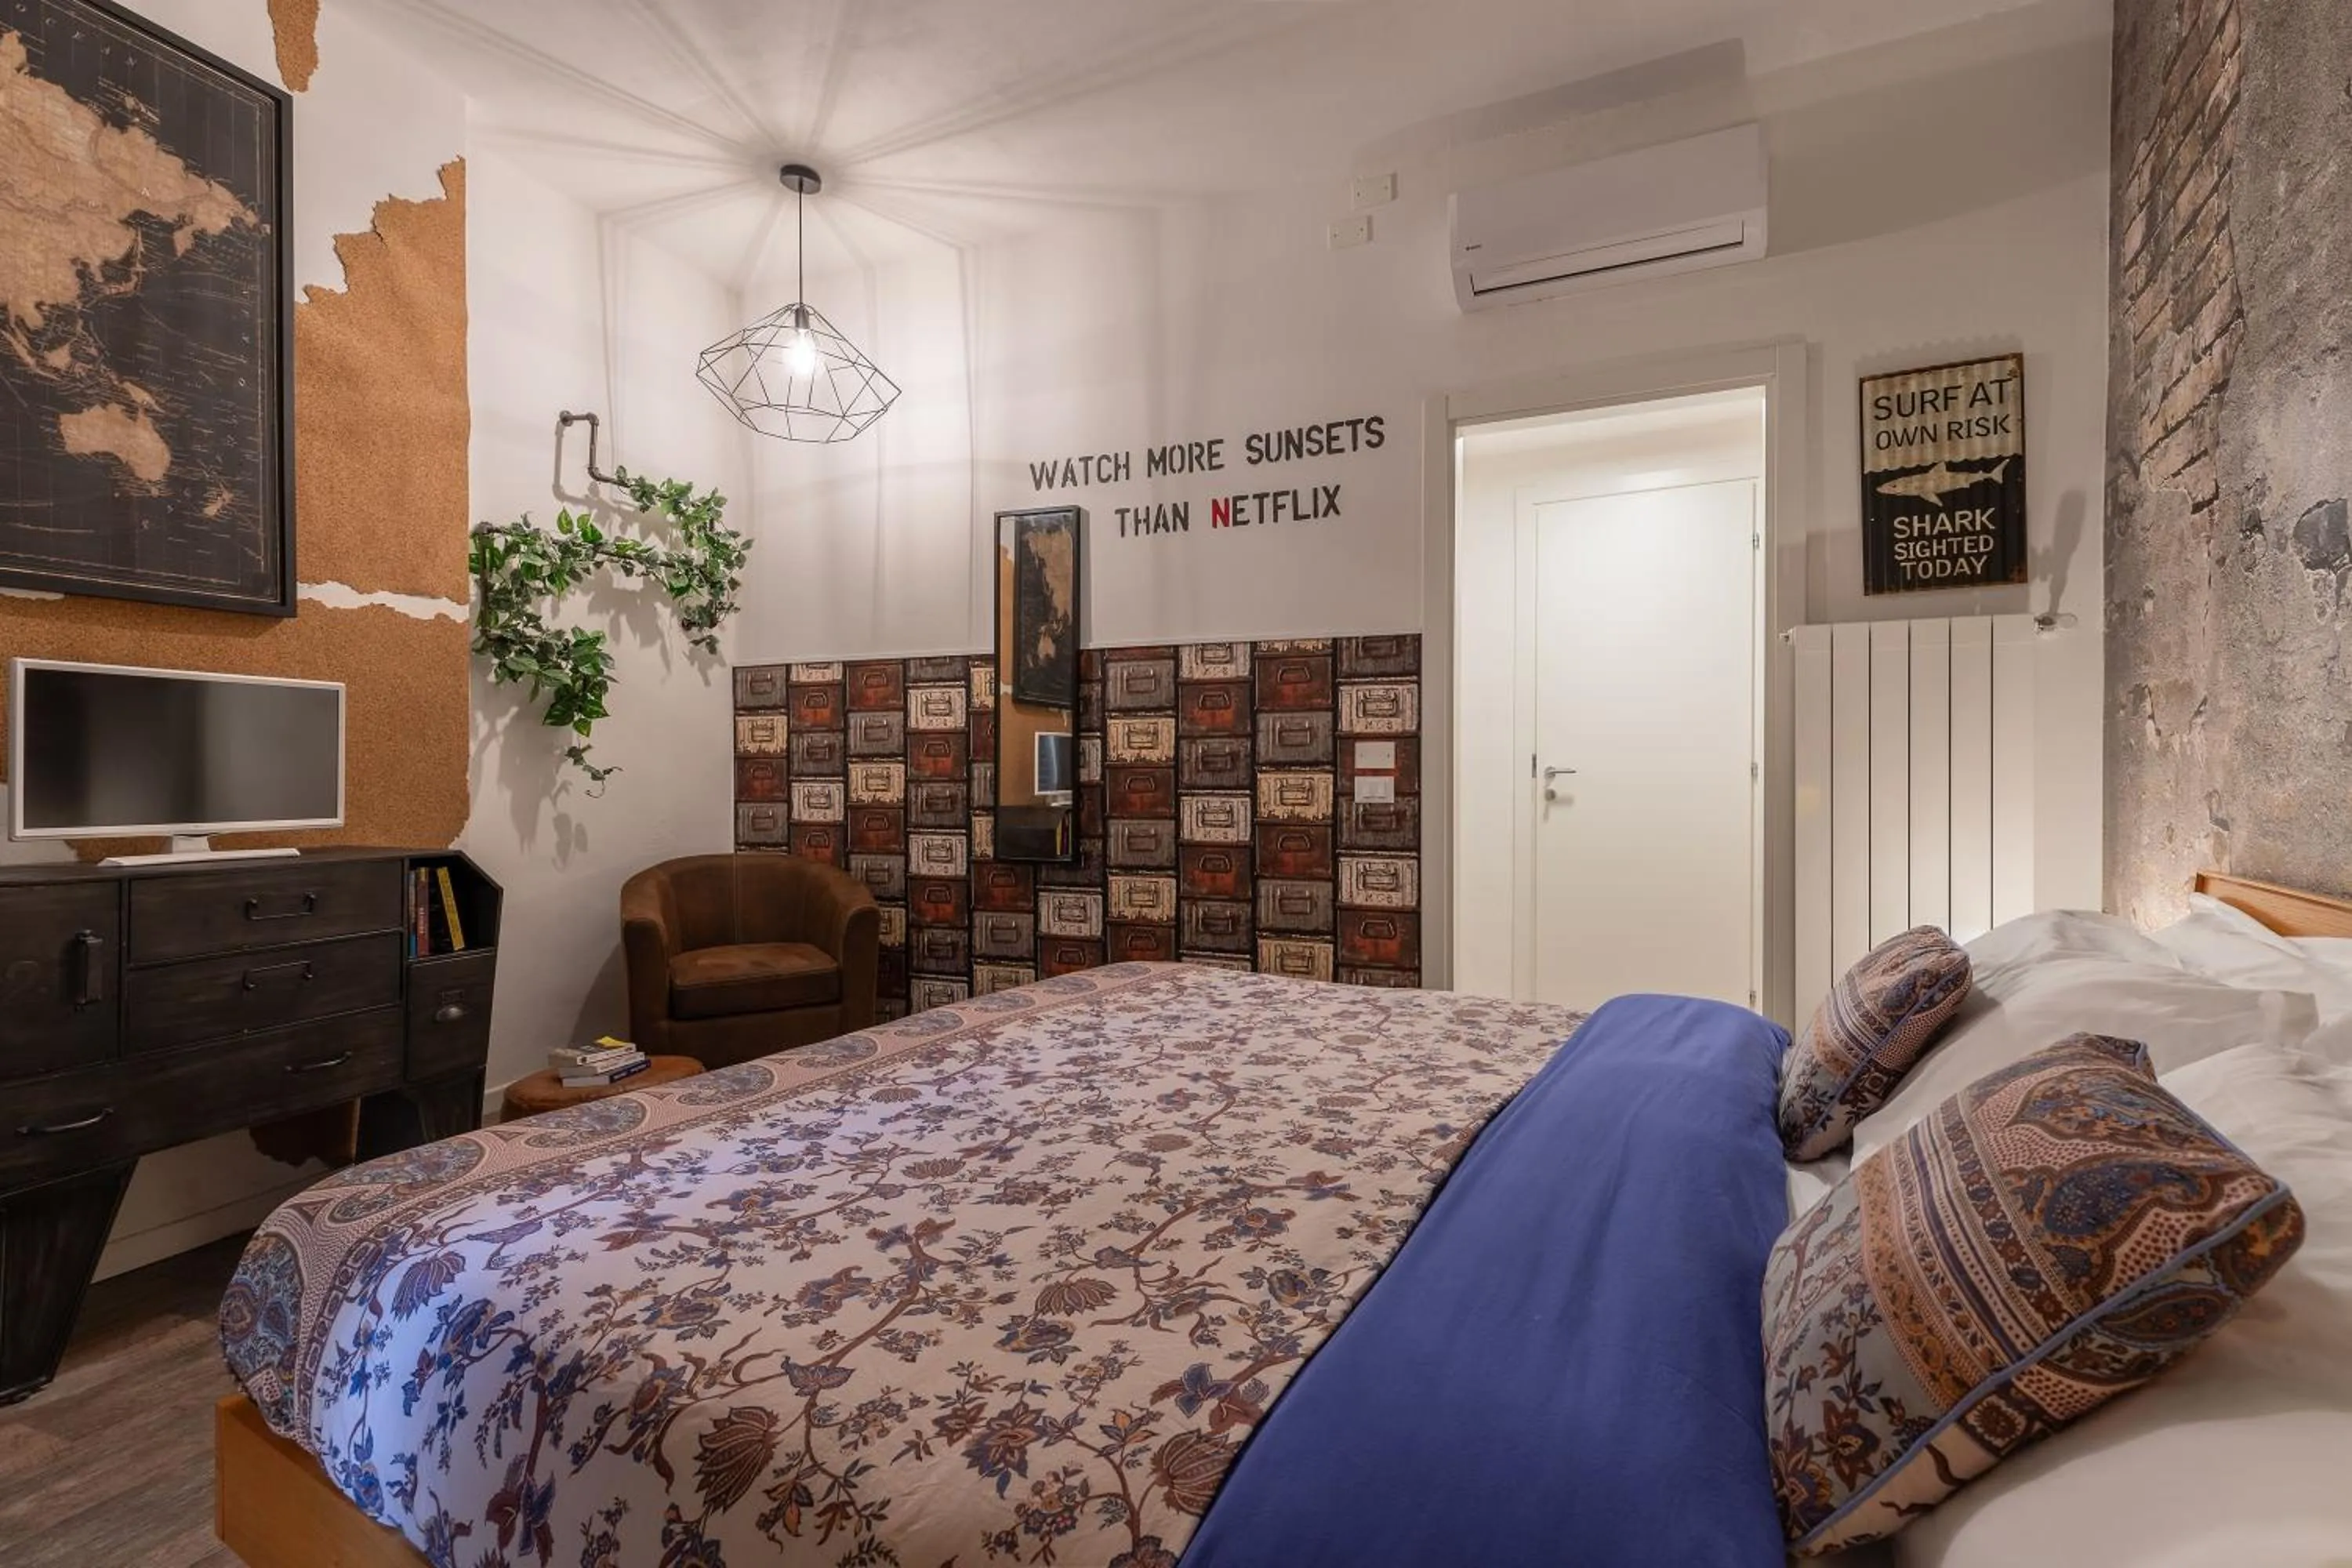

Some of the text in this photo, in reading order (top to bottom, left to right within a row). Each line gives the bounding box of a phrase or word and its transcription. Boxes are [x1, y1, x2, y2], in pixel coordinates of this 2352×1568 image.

[1873, 377, 2013, 421] SURF AT
[1875, 413, 2011, 452] OWN RISK
[1029, 416, 1385, 492] WATCH MORE SUNSETS
[1114, 485, 1341, 539] THAN NETFLIX
[1893, 507, 1996, 539] SHARK
[1893, 535, 1994, 561] SIGHTED
[1900, 554, 1988, 581] TODAY
